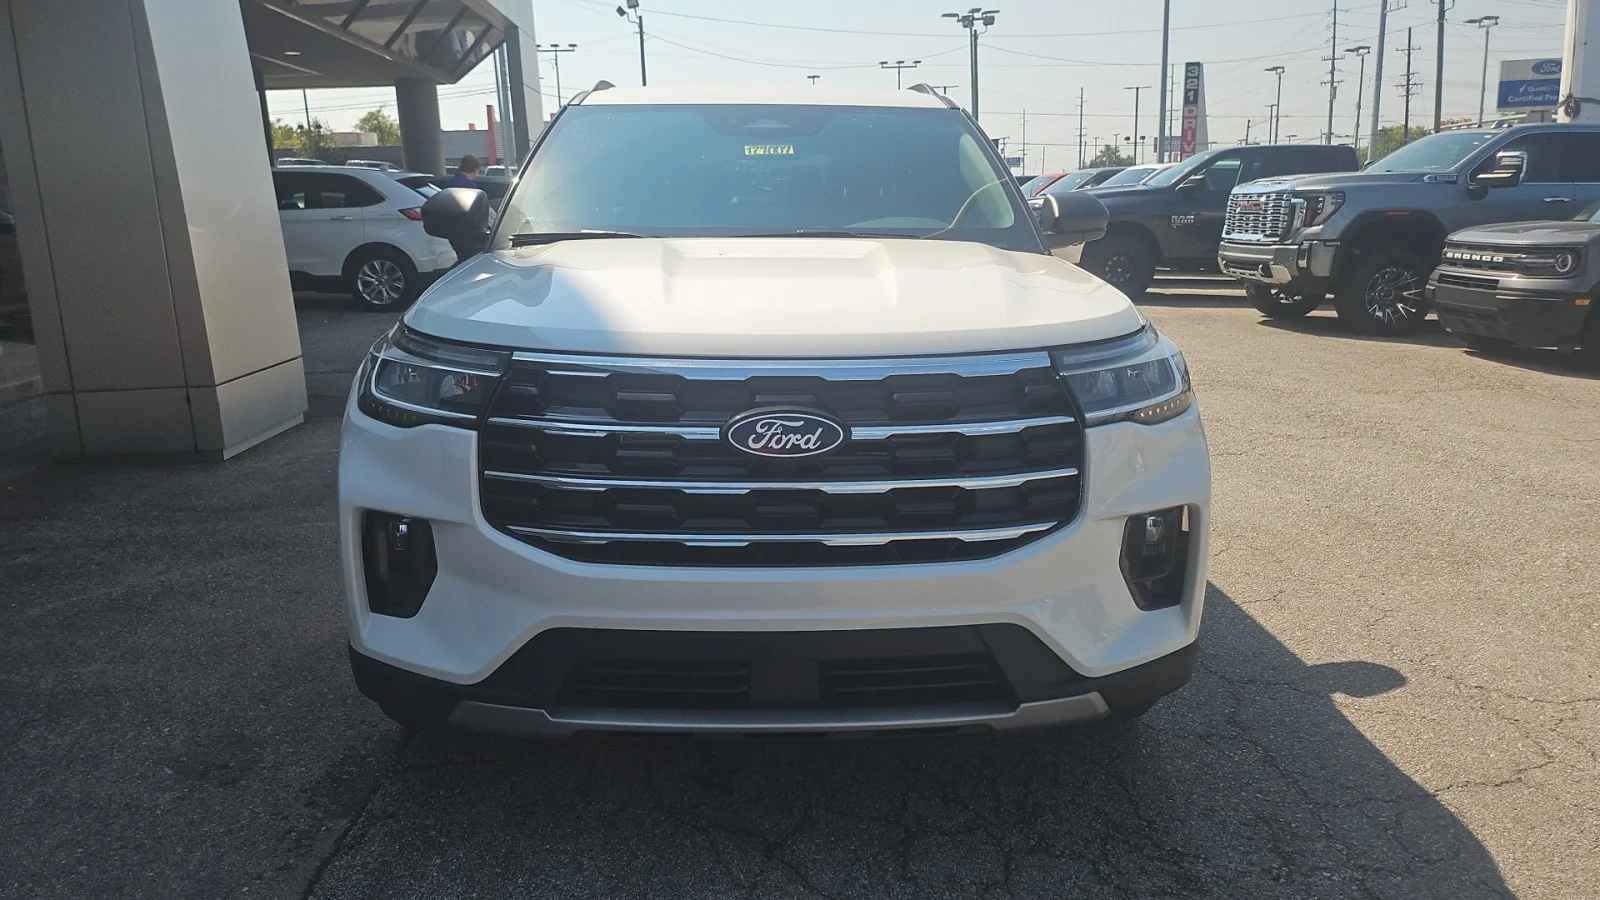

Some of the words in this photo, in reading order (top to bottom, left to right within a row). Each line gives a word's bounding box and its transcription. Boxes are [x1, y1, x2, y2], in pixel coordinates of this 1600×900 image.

[1186, 65, 1199, 101] 321
[1507, 94, 1543, 103] Certified
[1446, 252, 1504, 262] BRONCO
[748, 419, 823, 449] Ford
